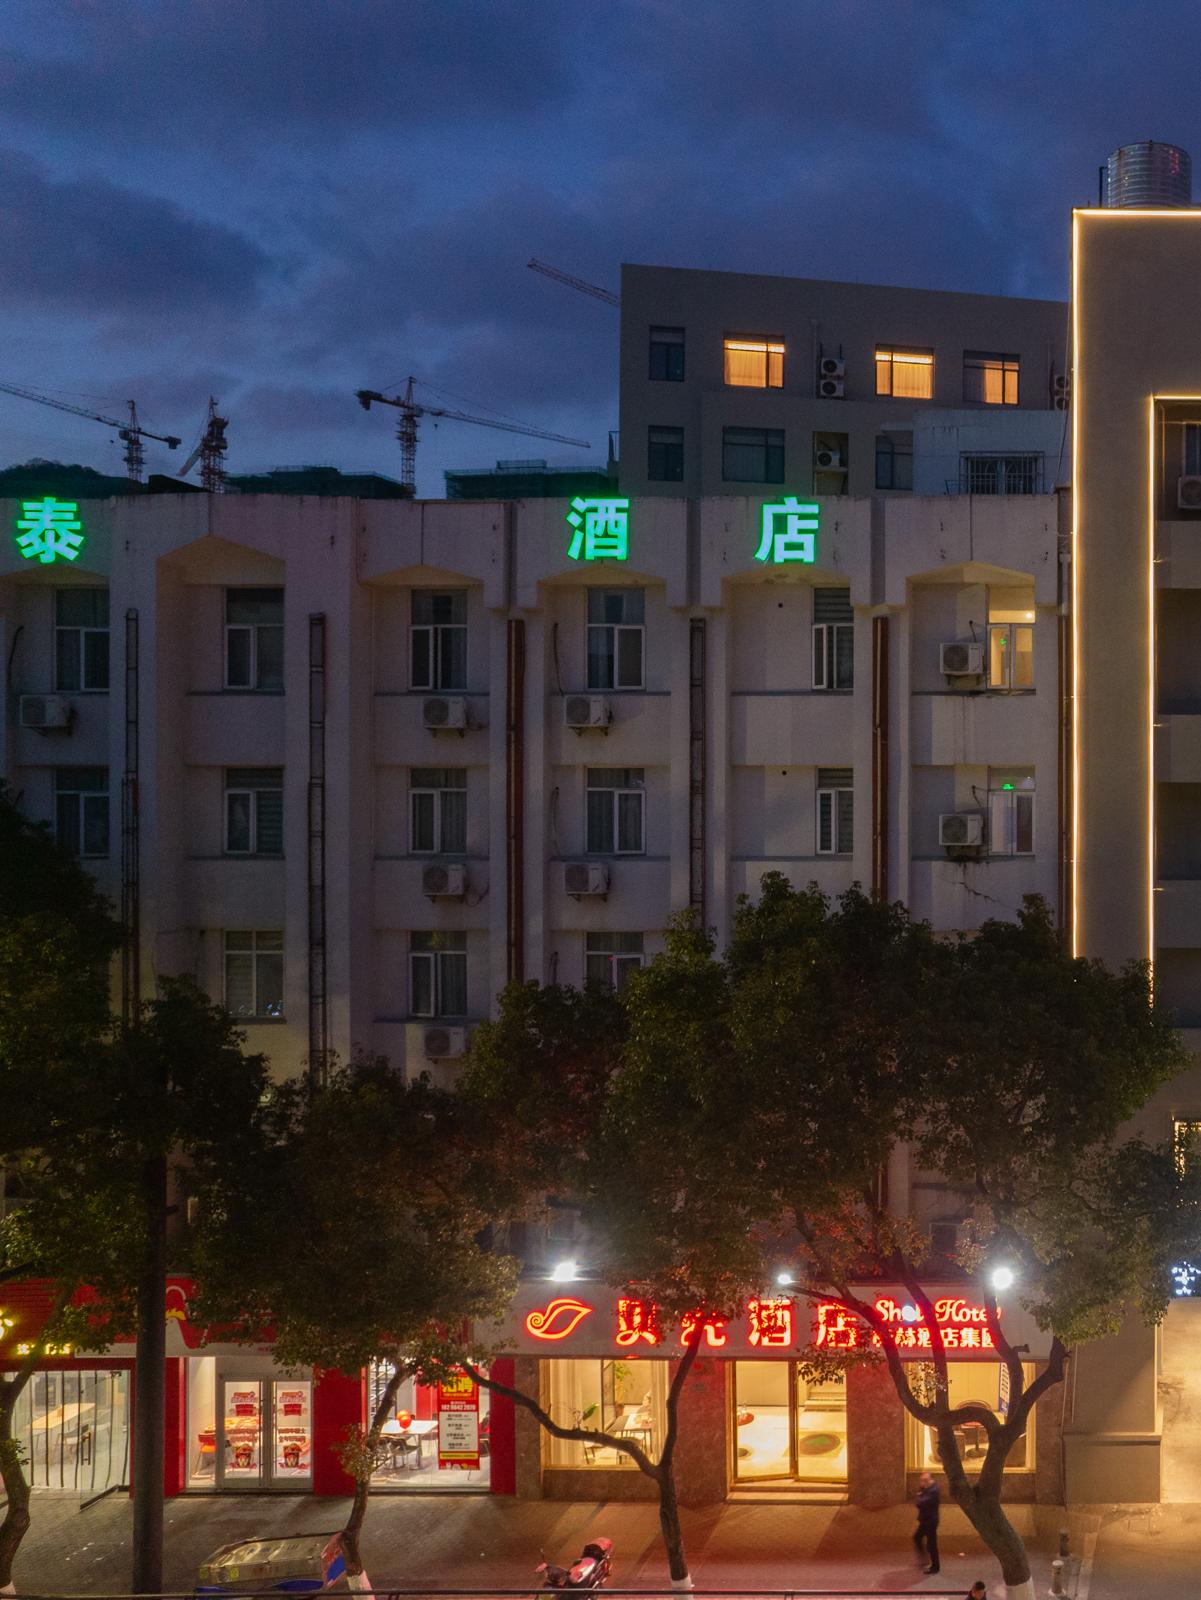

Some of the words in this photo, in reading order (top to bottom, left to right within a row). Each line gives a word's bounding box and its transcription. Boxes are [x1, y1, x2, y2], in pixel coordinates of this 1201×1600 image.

[16, 497, 83, 564] 泰
[567, 496, 819, 564] 酒店
[935, 1296, 1002, 1322] Hote
[872, 1327, 996, 1348] 林酒店集团
